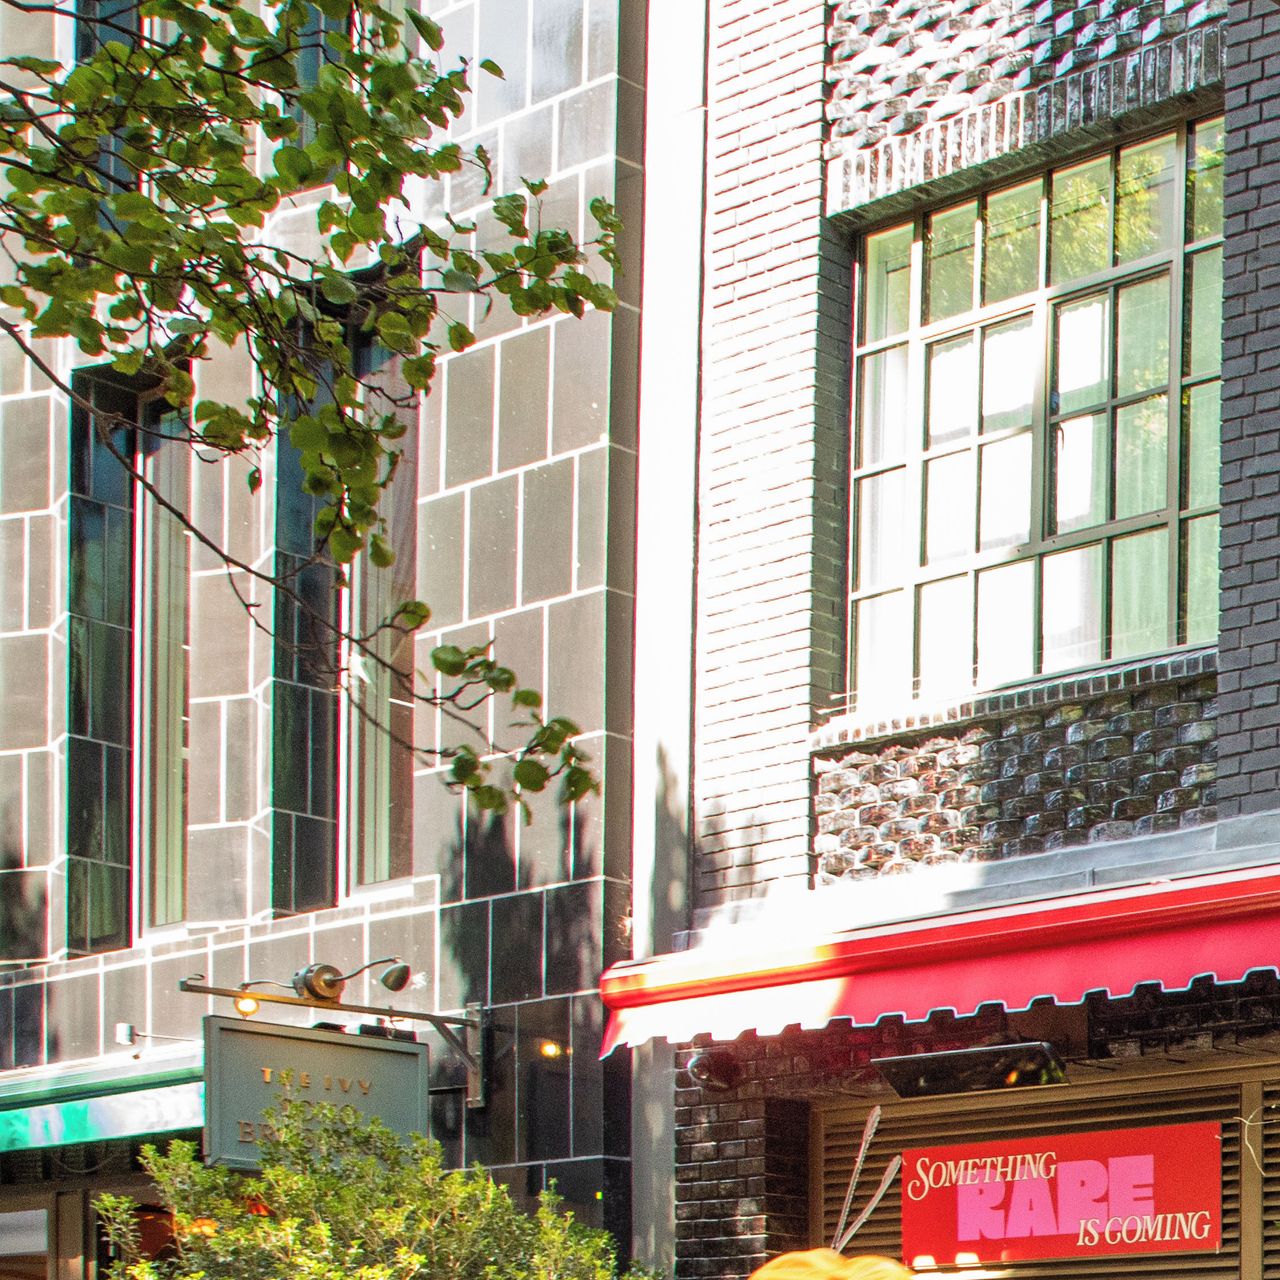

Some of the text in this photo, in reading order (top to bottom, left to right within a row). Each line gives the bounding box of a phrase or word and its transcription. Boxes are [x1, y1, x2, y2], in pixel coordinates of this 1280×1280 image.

[907, 1151, 1057, 1201] SOMETHING
[956, 1154, 1154, 1242] RARE
[1077, 1211, 1211, 1246] IS COMING
